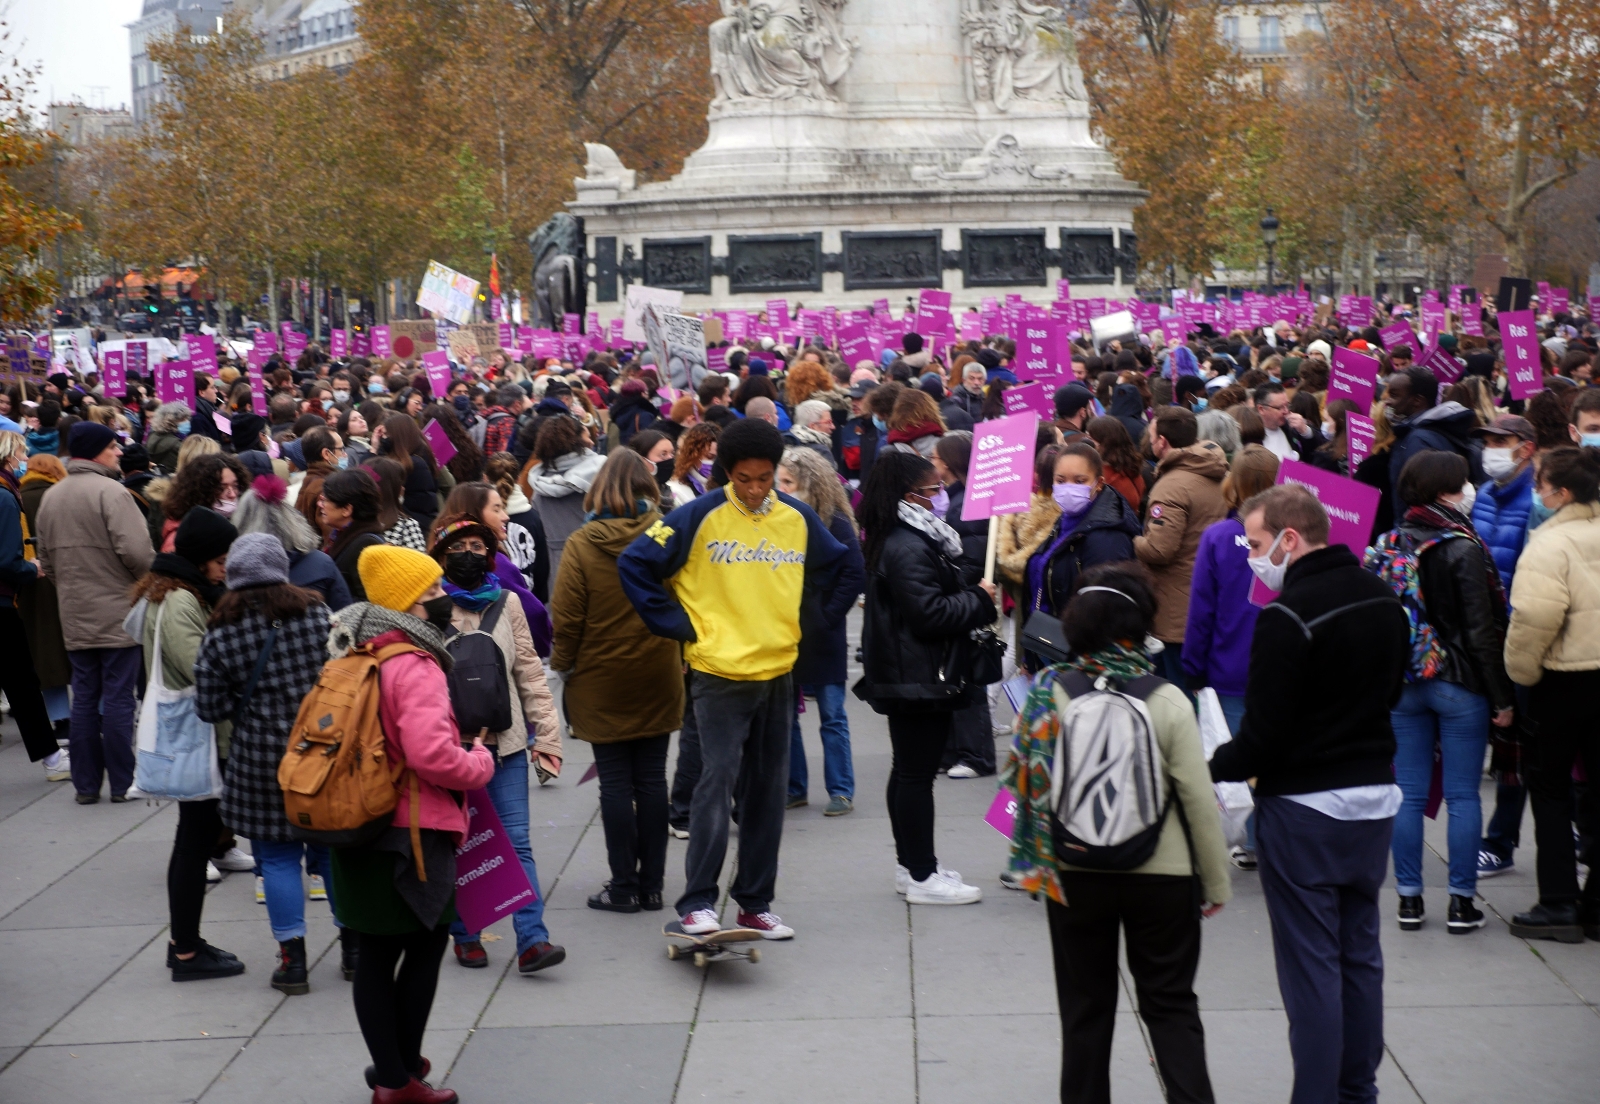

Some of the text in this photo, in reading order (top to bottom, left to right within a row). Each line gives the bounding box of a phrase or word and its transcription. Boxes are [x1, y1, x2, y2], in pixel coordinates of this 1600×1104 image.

[663, 313, 704, 334] REMEMBER
[1508, 324, 1528, 337] Ras
[1027, 328, 1047, 338] Ras
[1031, 343, 1042, 353] le
[1516, 345, 1528, 359] le
[1026, 359, 1048, 369] viol
[1336, 360, 1345, 369] La
[169, 369, 187, 379] Ras
[1335, 370, 1372, 387] transphobie
[1515, 366, 1534, 382] viol
[174, 383, 184, 393] le
[1333, 379, 1352, 393] tue.
[1009, 402, 1029, 410] crois.
[979, 435, 1004, 450] 65%
[1352, 438, 1367, 452] Bla
[645, 519, 676, 548] M
[706, 537, 805, 571] Michigan
[455, 828, 495, 857] vention
[455, 855, 505, 889] ormation
